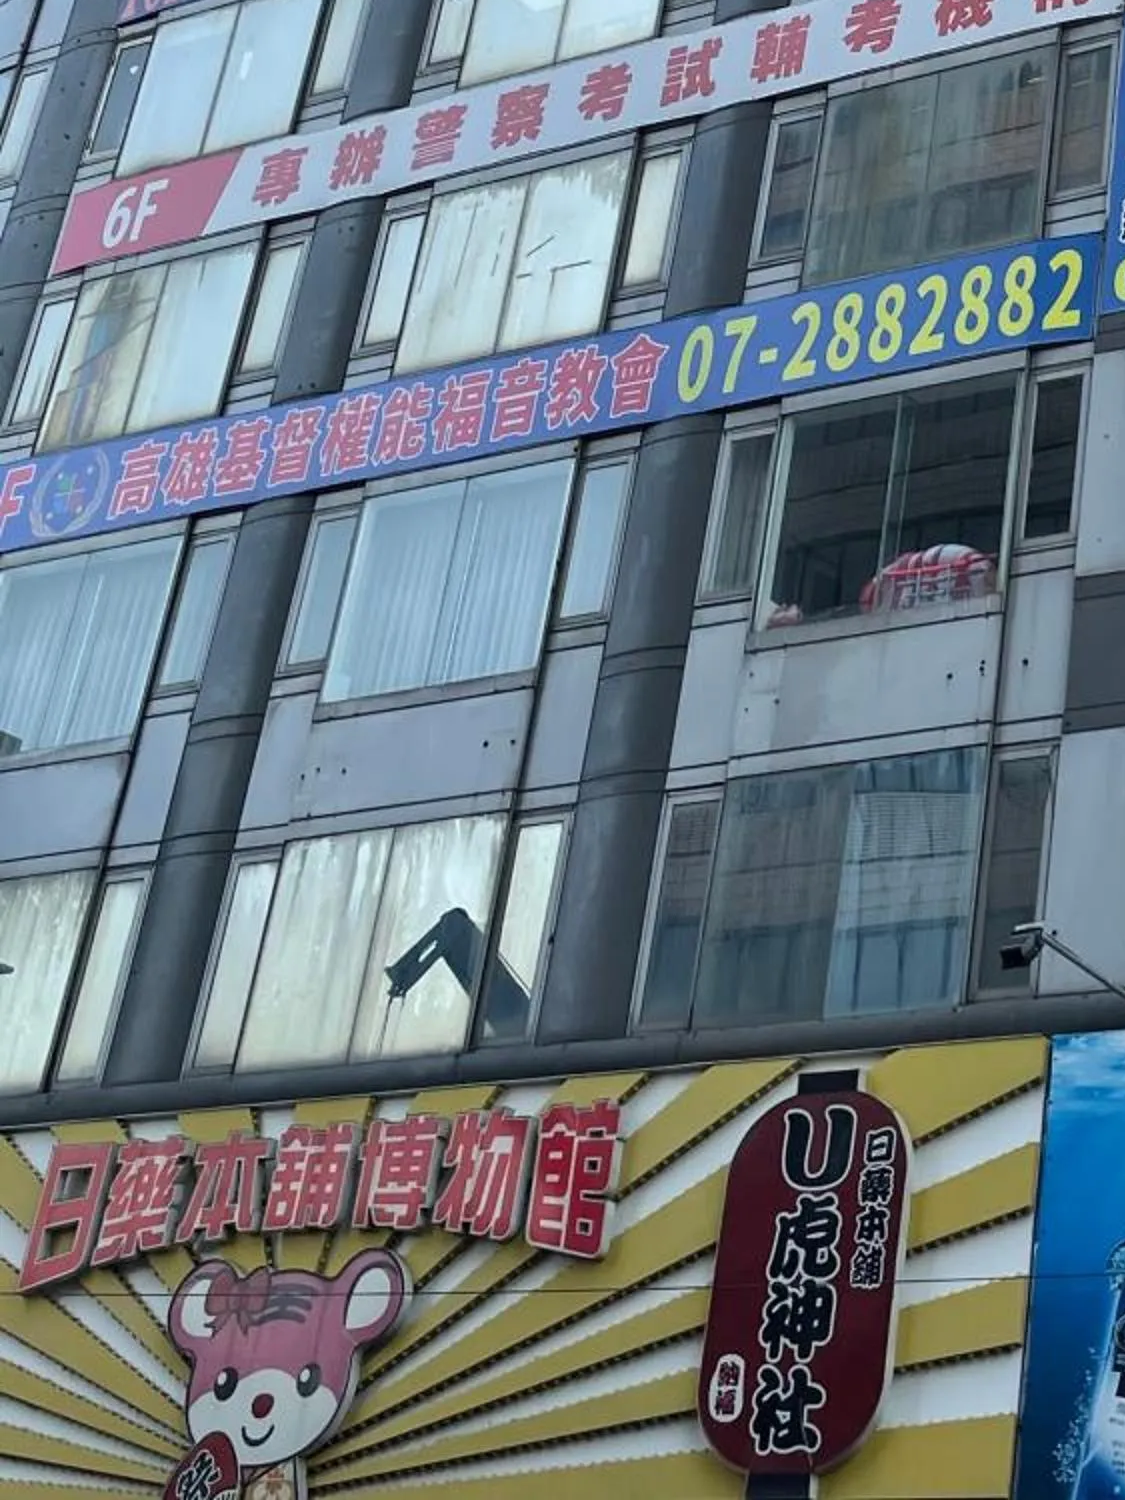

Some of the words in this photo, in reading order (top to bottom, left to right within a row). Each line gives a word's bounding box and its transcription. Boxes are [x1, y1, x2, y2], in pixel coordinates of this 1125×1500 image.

[102, 178, 169, 249] 6F
[106, 331, 671, 521] 高雄基督權能福音教會
[677, 248, 1084, 404] 07-2882882
[19, 1098, 628, 1295] 日藥本舖博物館
